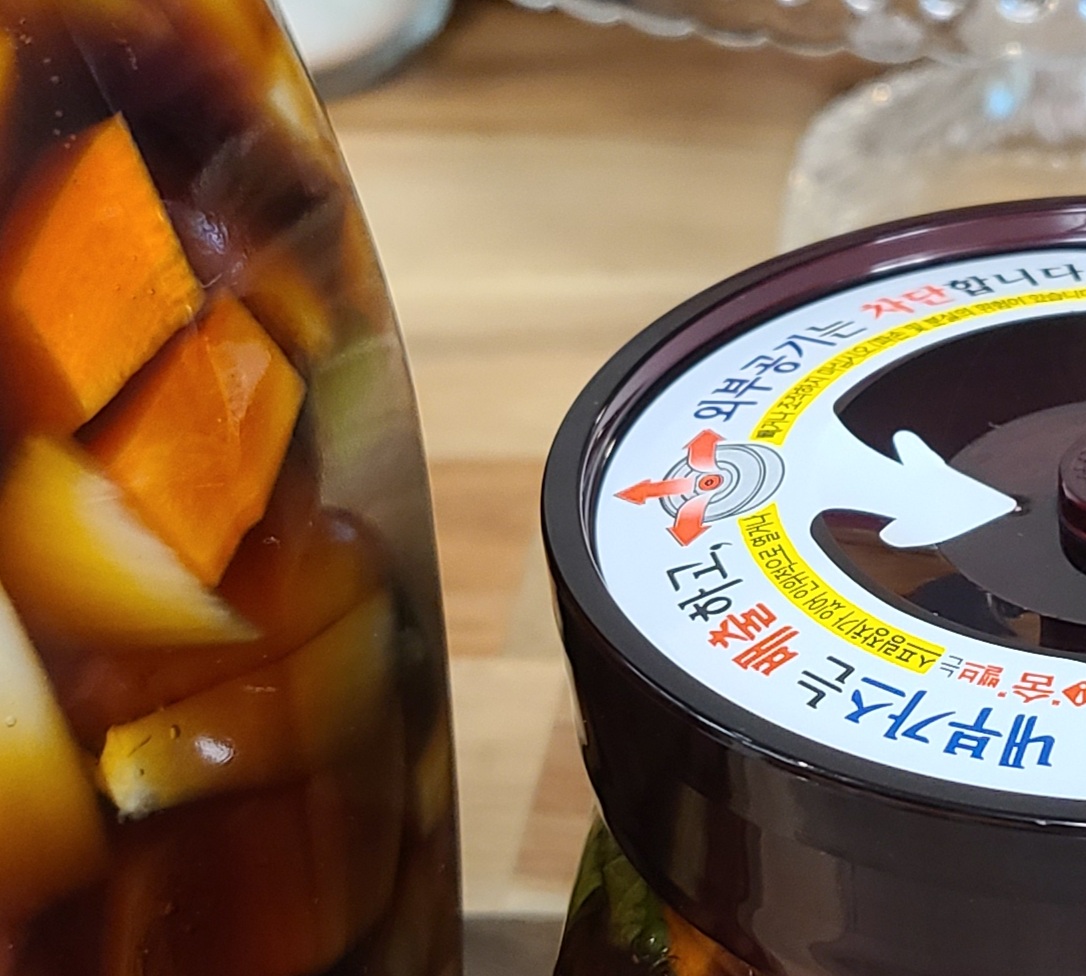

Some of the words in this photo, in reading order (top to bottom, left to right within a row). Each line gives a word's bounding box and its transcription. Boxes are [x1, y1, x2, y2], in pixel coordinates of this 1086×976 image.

[693, 320, 868, 422] 외부공기는
[742, 512, 780, 547] 열거나
[758, 543, 820, 600] 인위적으로
[666, 542, 800, 676] 배출하고,
[802, 591, 846, 620] 있어
[831, 610, 942, 668] 스프링장치가
[940, 654, 1004, 688] 밸브는
[797, 655, 1056, 769] 내부가스는
